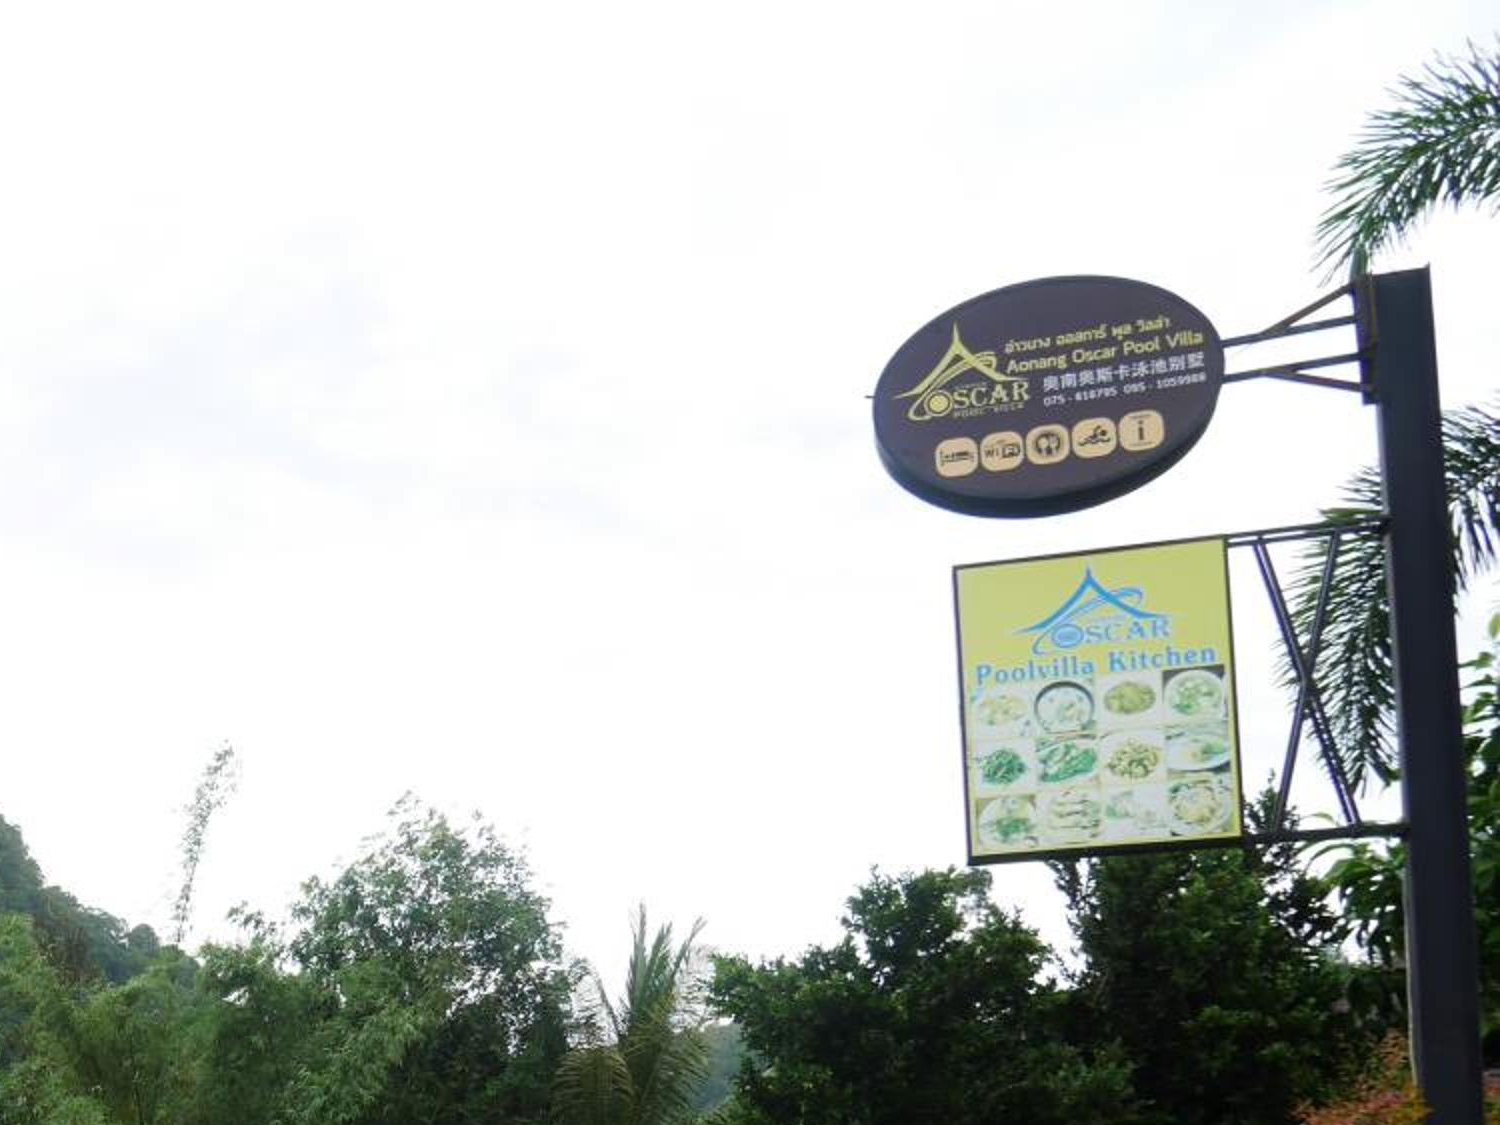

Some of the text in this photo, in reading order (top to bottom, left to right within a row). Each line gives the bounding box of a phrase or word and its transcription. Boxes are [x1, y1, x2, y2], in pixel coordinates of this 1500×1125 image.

[1007, 330, 1204, 374] Aonang Oscar Pool Villa
[923, 380, 1030, 417] OSCAR
[1051, 616, 1172, 649] OSCAR
[975, 645, 1216, 687] Poolvilla Kitchen
